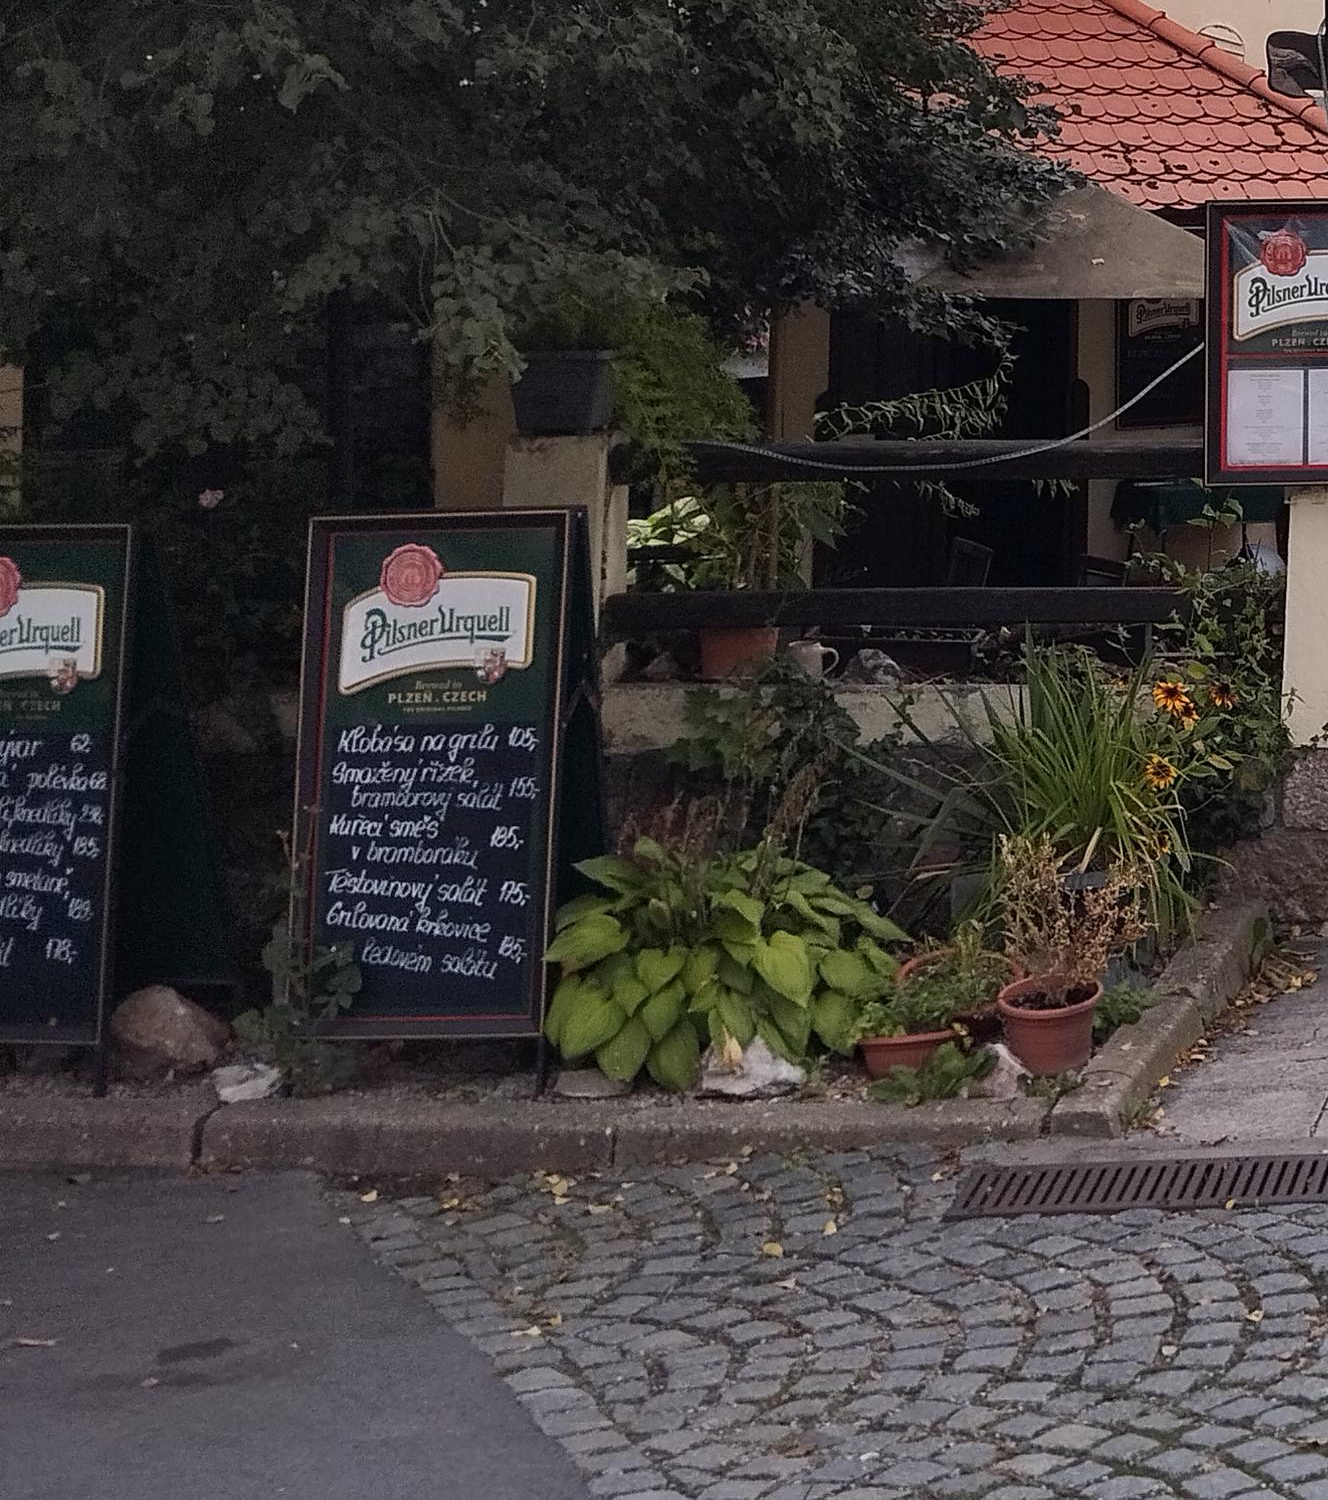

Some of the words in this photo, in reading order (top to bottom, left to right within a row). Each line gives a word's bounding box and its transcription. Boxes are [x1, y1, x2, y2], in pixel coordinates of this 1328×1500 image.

[1248, 276, 1307, 318] Pilsner
[17, 614, 81, 654] Urquell
[360, 607, 440, 663] Pilsner
[438, 605, 510, 644] Urquell
[442, 690, 487, 702] CZECH
[0, 729, 42, 766] ývar
[337, 724, 414, 753] Klobása
[420, 734, 446, 752] na
[447, 723, 500, 763] grilu
[332, 758, 424, 793] Smažený
[454, 782, 504, 811] salát
[329, 814, 388, 836] Kuřecí
[389, 815, 440, 839] směs
[352, 846, 362, 861] v
[437, 876, 488, 906] salát
[326, 901, 413, 933] Grilovaná
[415, 904, 491, 943] krkovice
